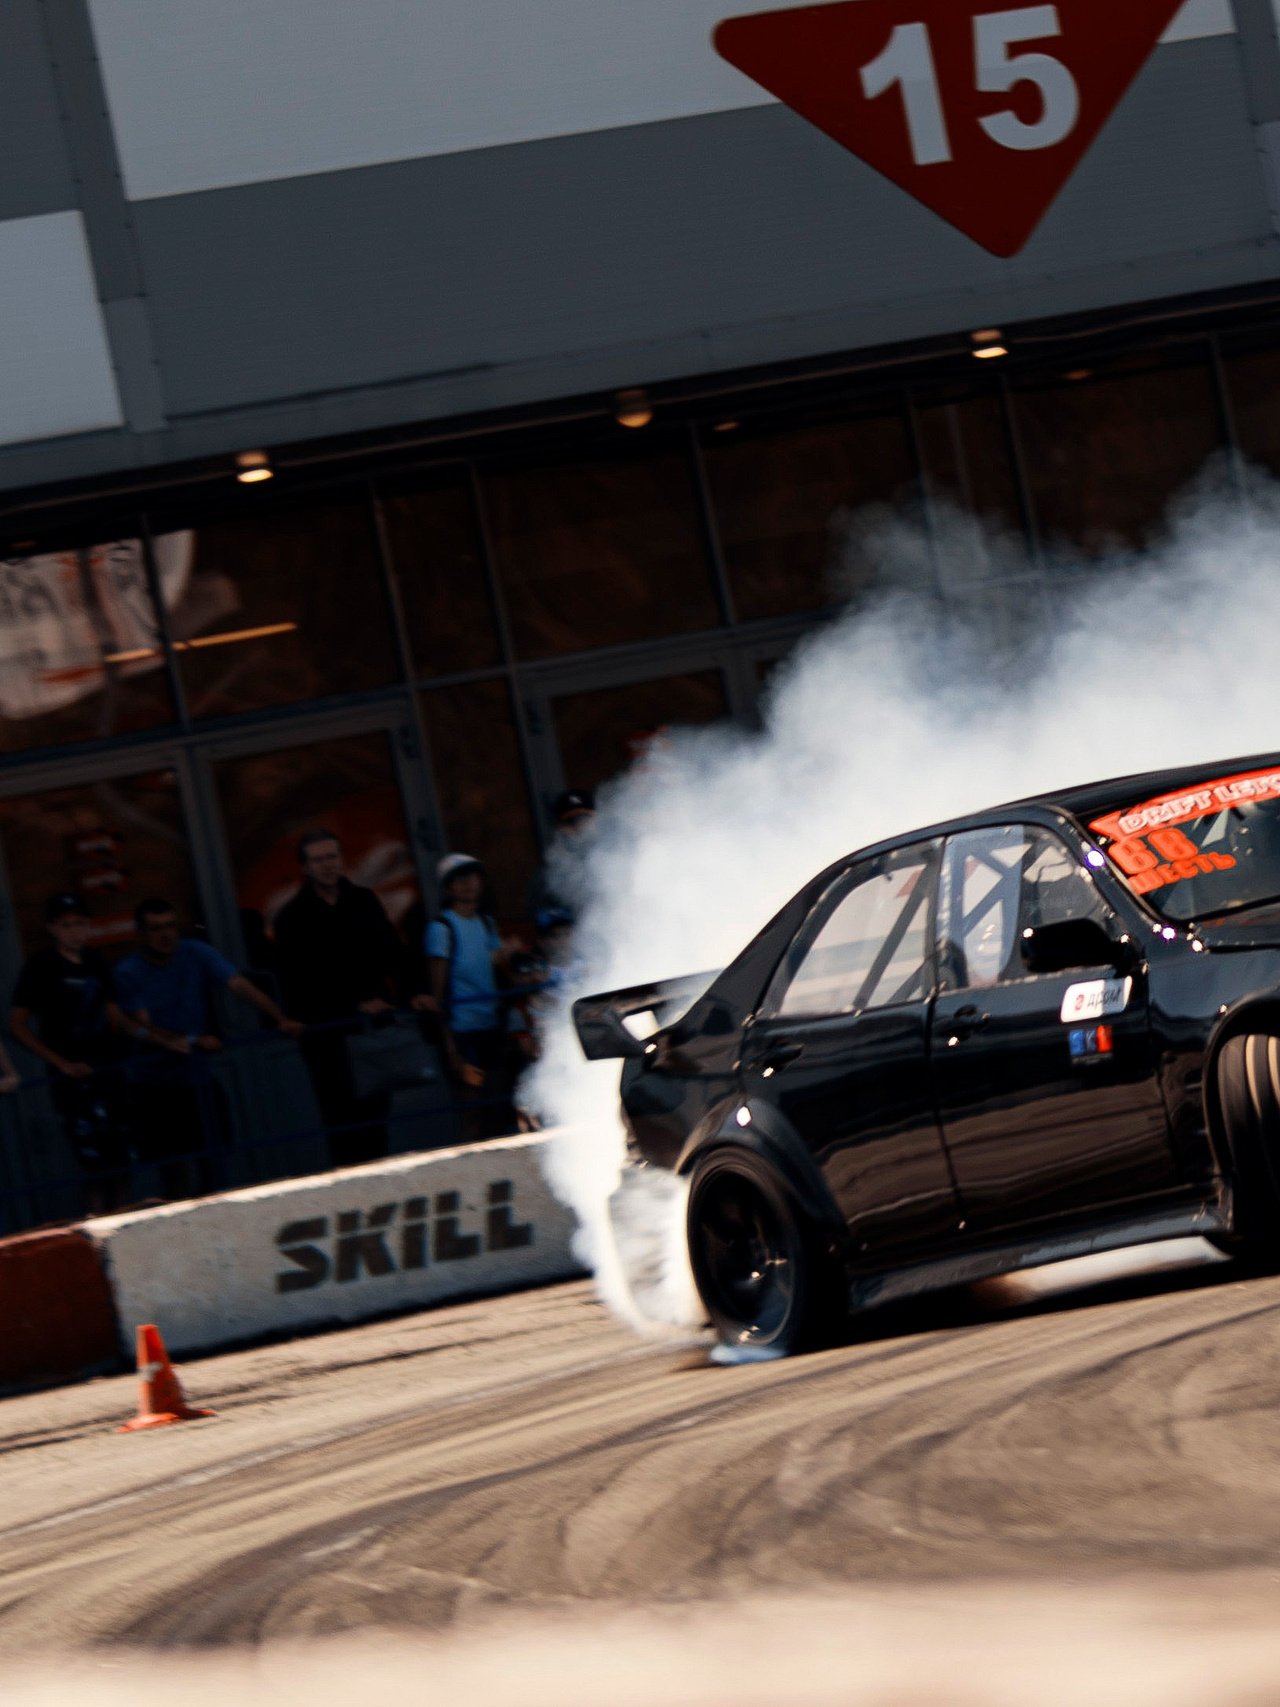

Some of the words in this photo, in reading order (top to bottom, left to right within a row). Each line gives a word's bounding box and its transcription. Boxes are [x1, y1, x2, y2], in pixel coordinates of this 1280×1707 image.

[859, 4, 1079, 165] 15
[1118, 790, 1212, 835] DRIFT
[1127, 852, 1236, 895] ШЕСТЬ
[274, 1179, 534, 1293] SKILL
